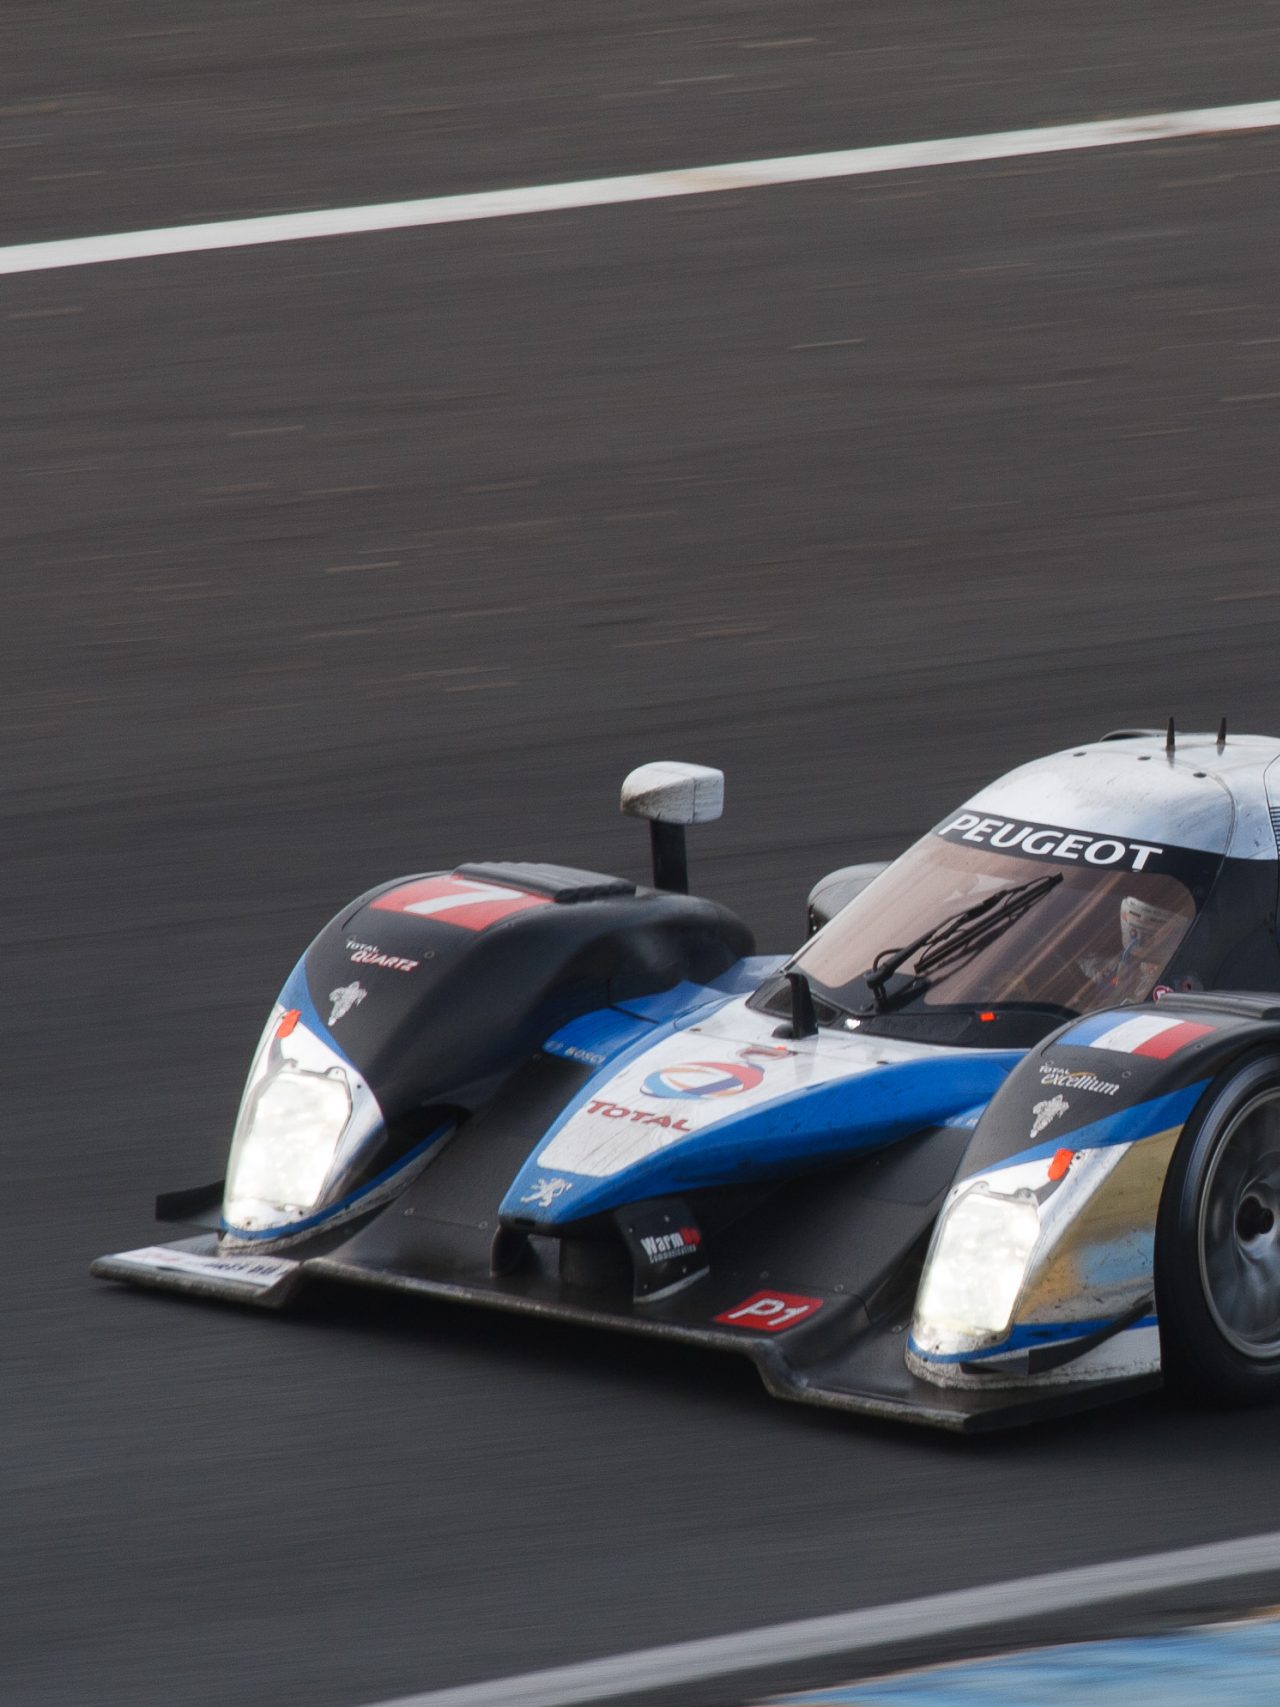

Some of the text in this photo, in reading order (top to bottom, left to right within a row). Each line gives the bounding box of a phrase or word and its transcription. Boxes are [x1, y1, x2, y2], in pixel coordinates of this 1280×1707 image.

[938, 813, 1163, 872] PEUGEOT
[403, 879, 529, 915] 7
[346, 939, 379, 953] TOTAL
[350, 950, 420, 972] QUARTZ
[1039, 1063, 1071, 1076] TOTAL
[1040, 1073, 1120, 1097] excellium
[586, 1100, 692, 1132] TOTAL
[728, 1298, 810, 1326] P1
